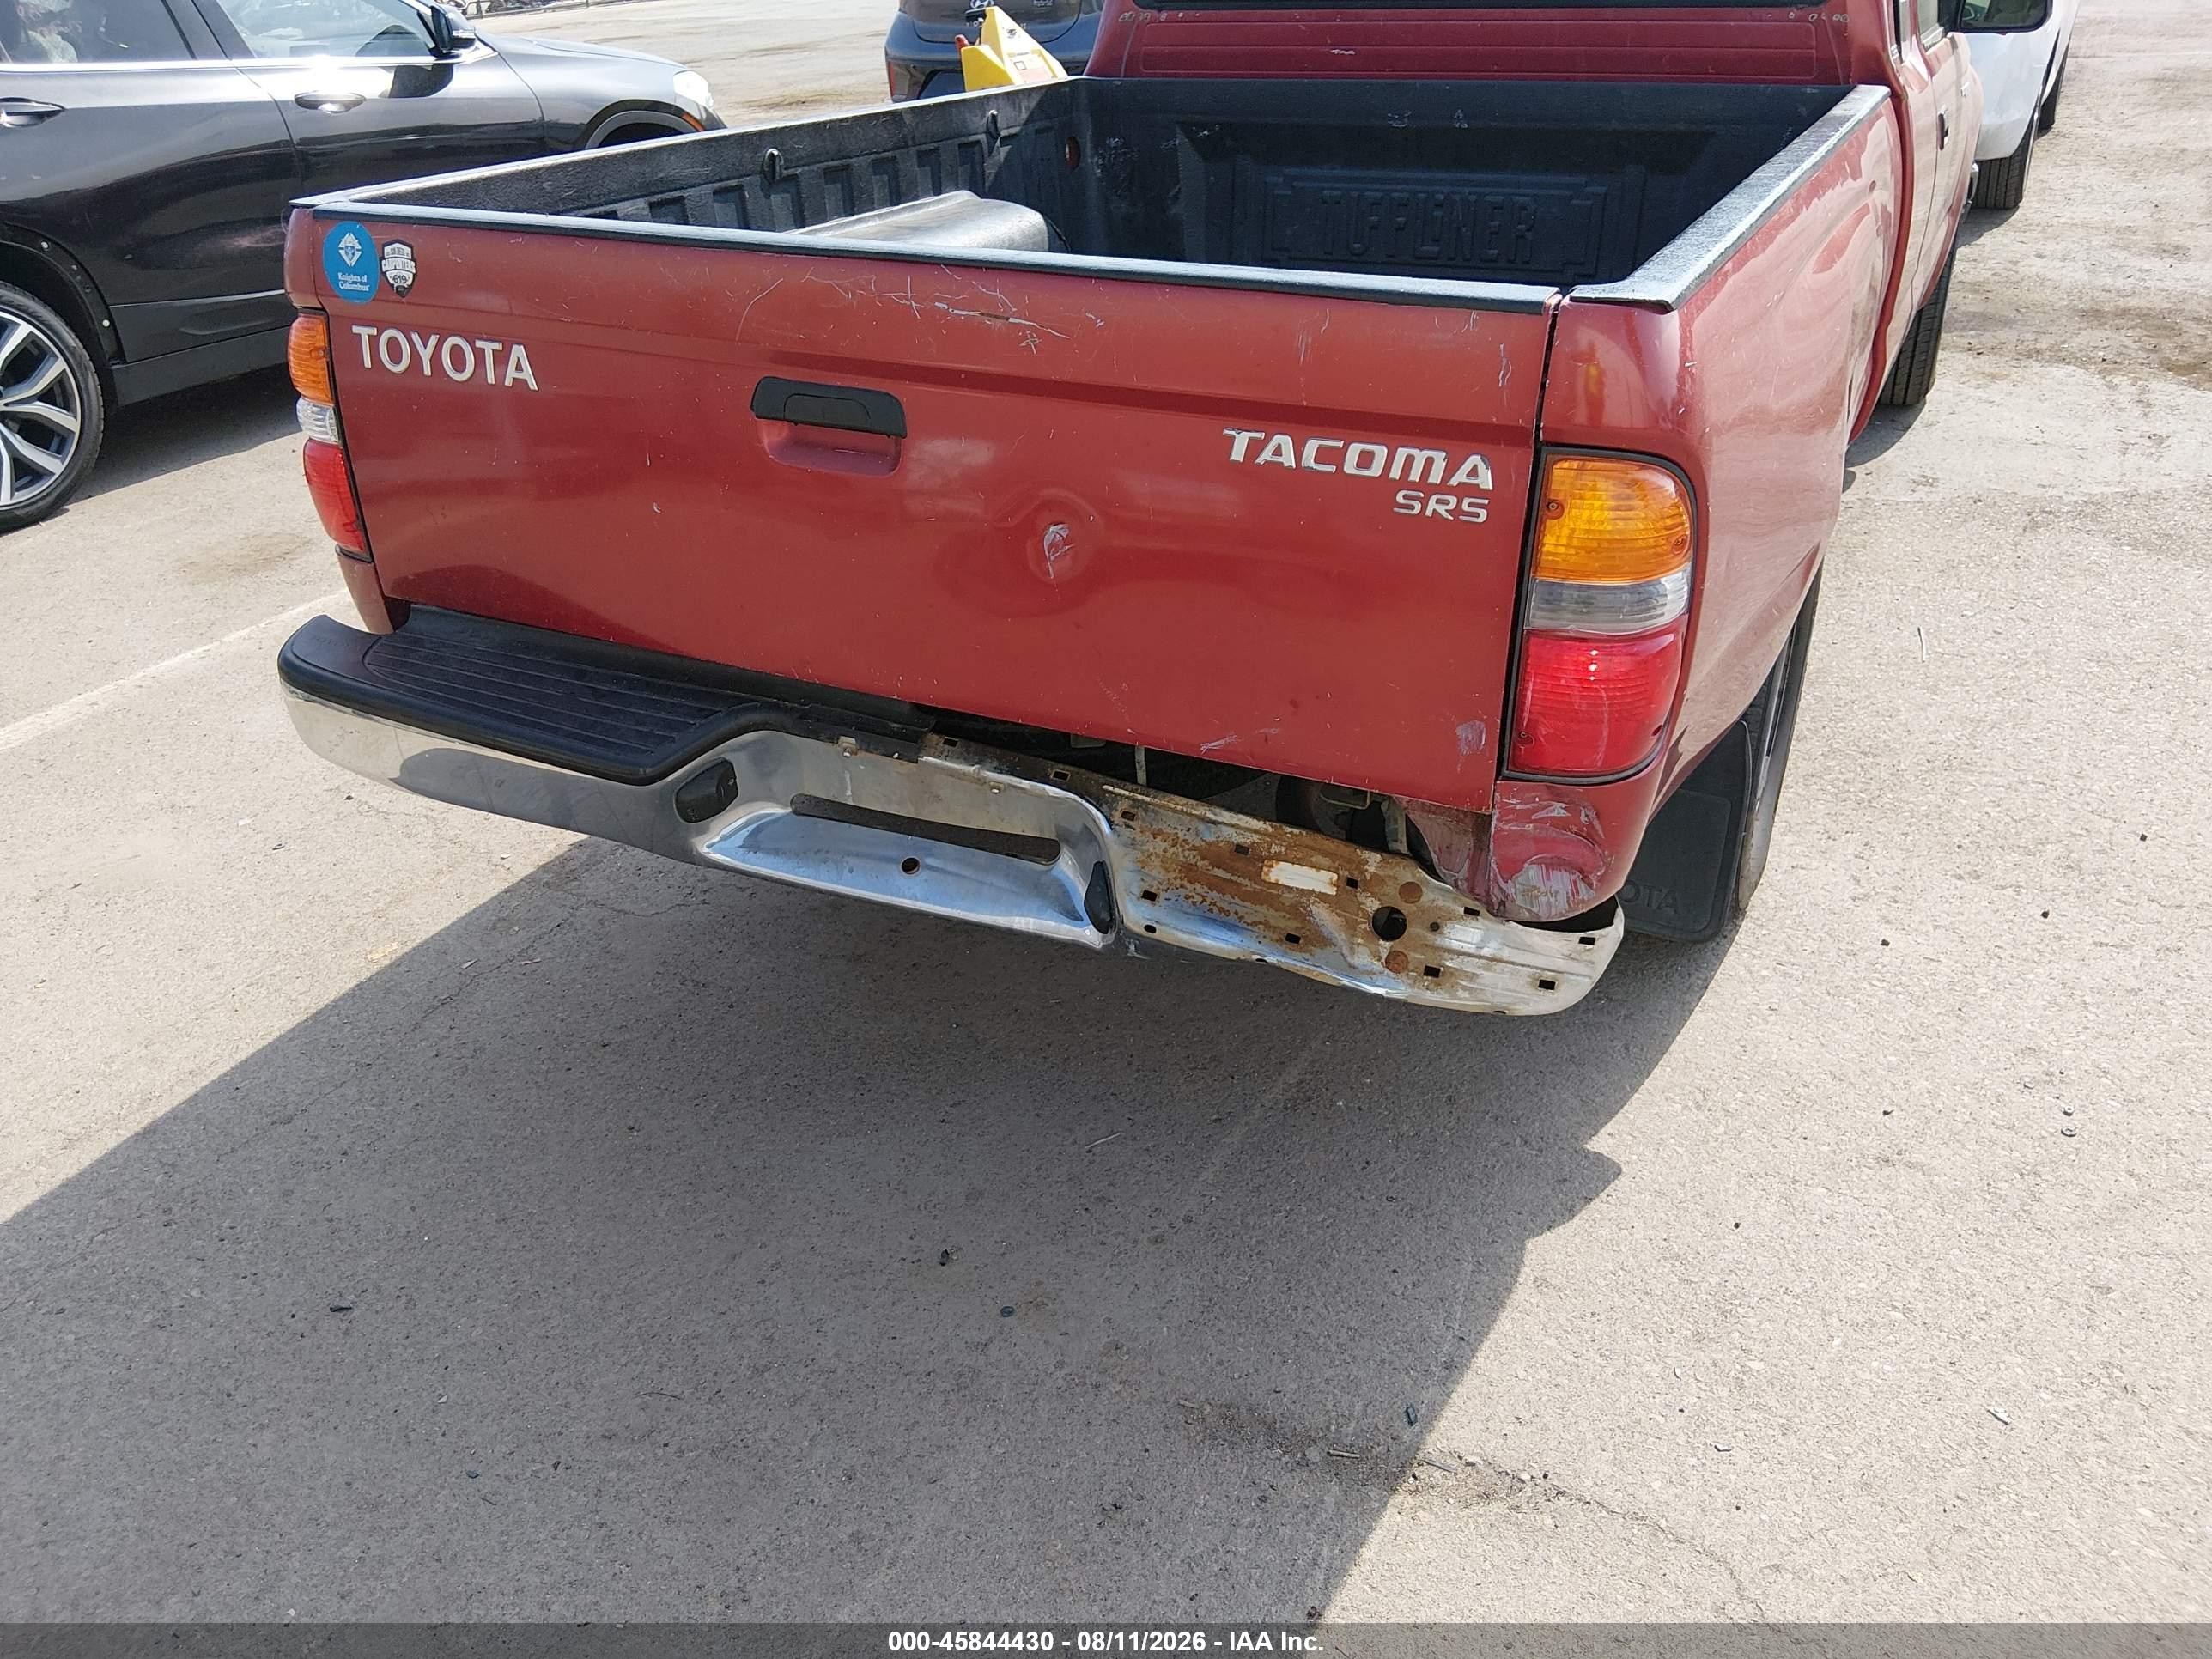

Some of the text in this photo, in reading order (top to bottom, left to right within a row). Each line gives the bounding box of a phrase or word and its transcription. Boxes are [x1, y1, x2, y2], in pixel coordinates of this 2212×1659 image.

[337, 272, 368, 283] Knights of
[392, 274, 408, 284] 619
[338, 281, 369, 292] Columbus
[351, 325, 539, 391] TOYOTA
[1223, 428, 1493, 490] TACOMA
